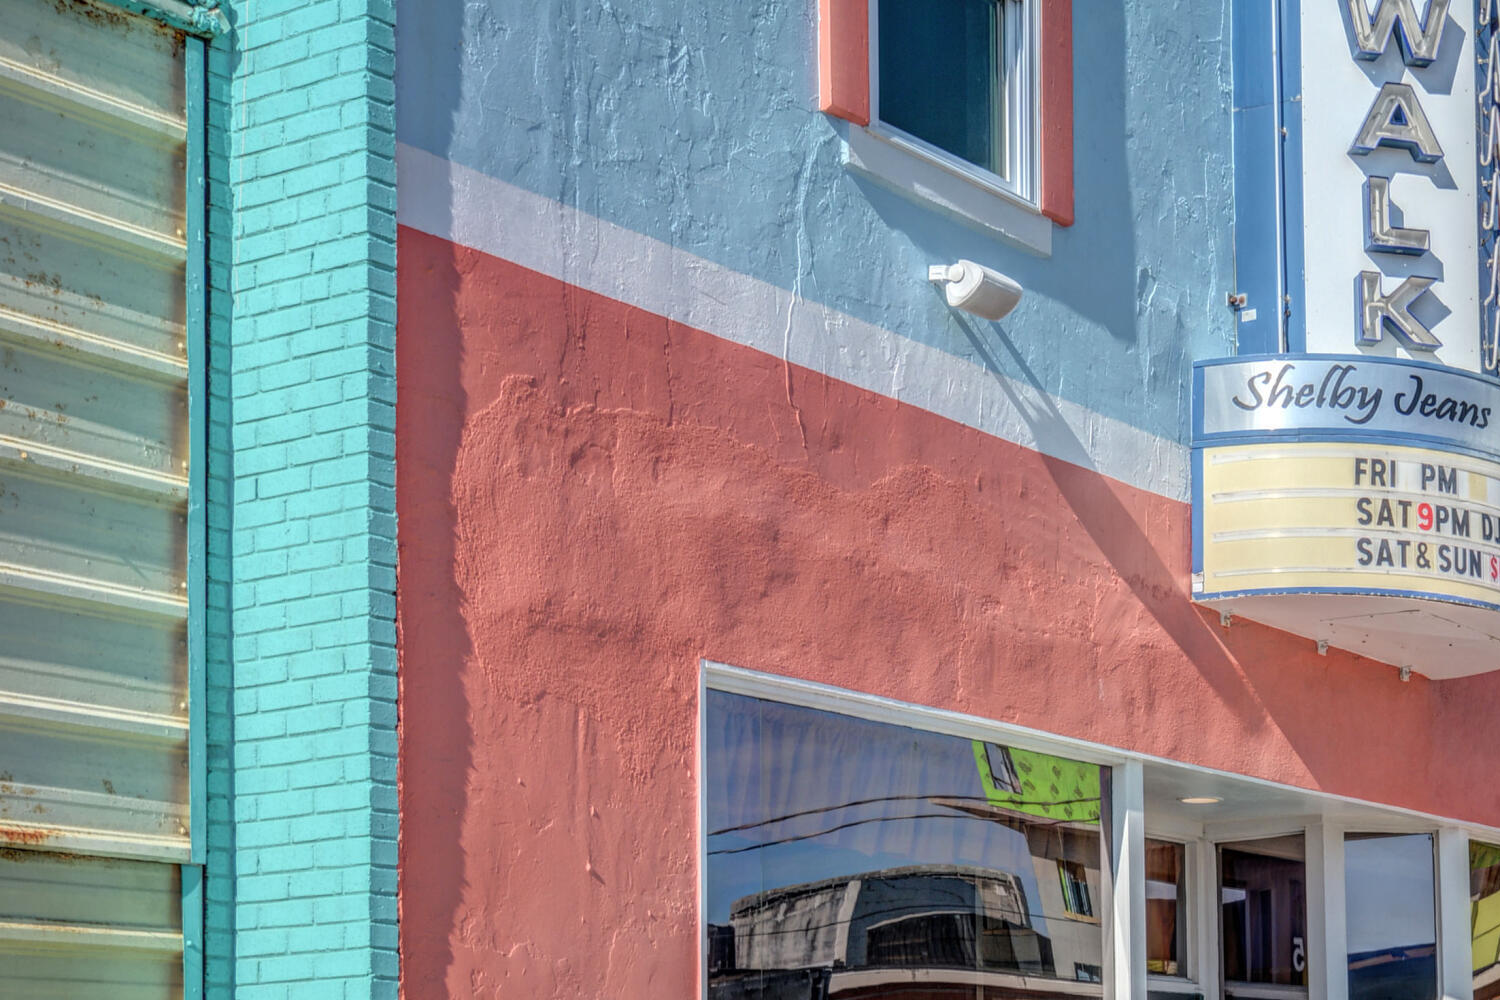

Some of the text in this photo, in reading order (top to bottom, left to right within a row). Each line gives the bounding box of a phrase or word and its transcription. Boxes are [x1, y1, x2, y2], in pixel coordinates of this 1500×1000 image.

[1232, 363, 1492, 430] Shelby Jeans
[1354, 457, 1459, 495] FRI PM
[1438, 543, 1483, 579] SUN
